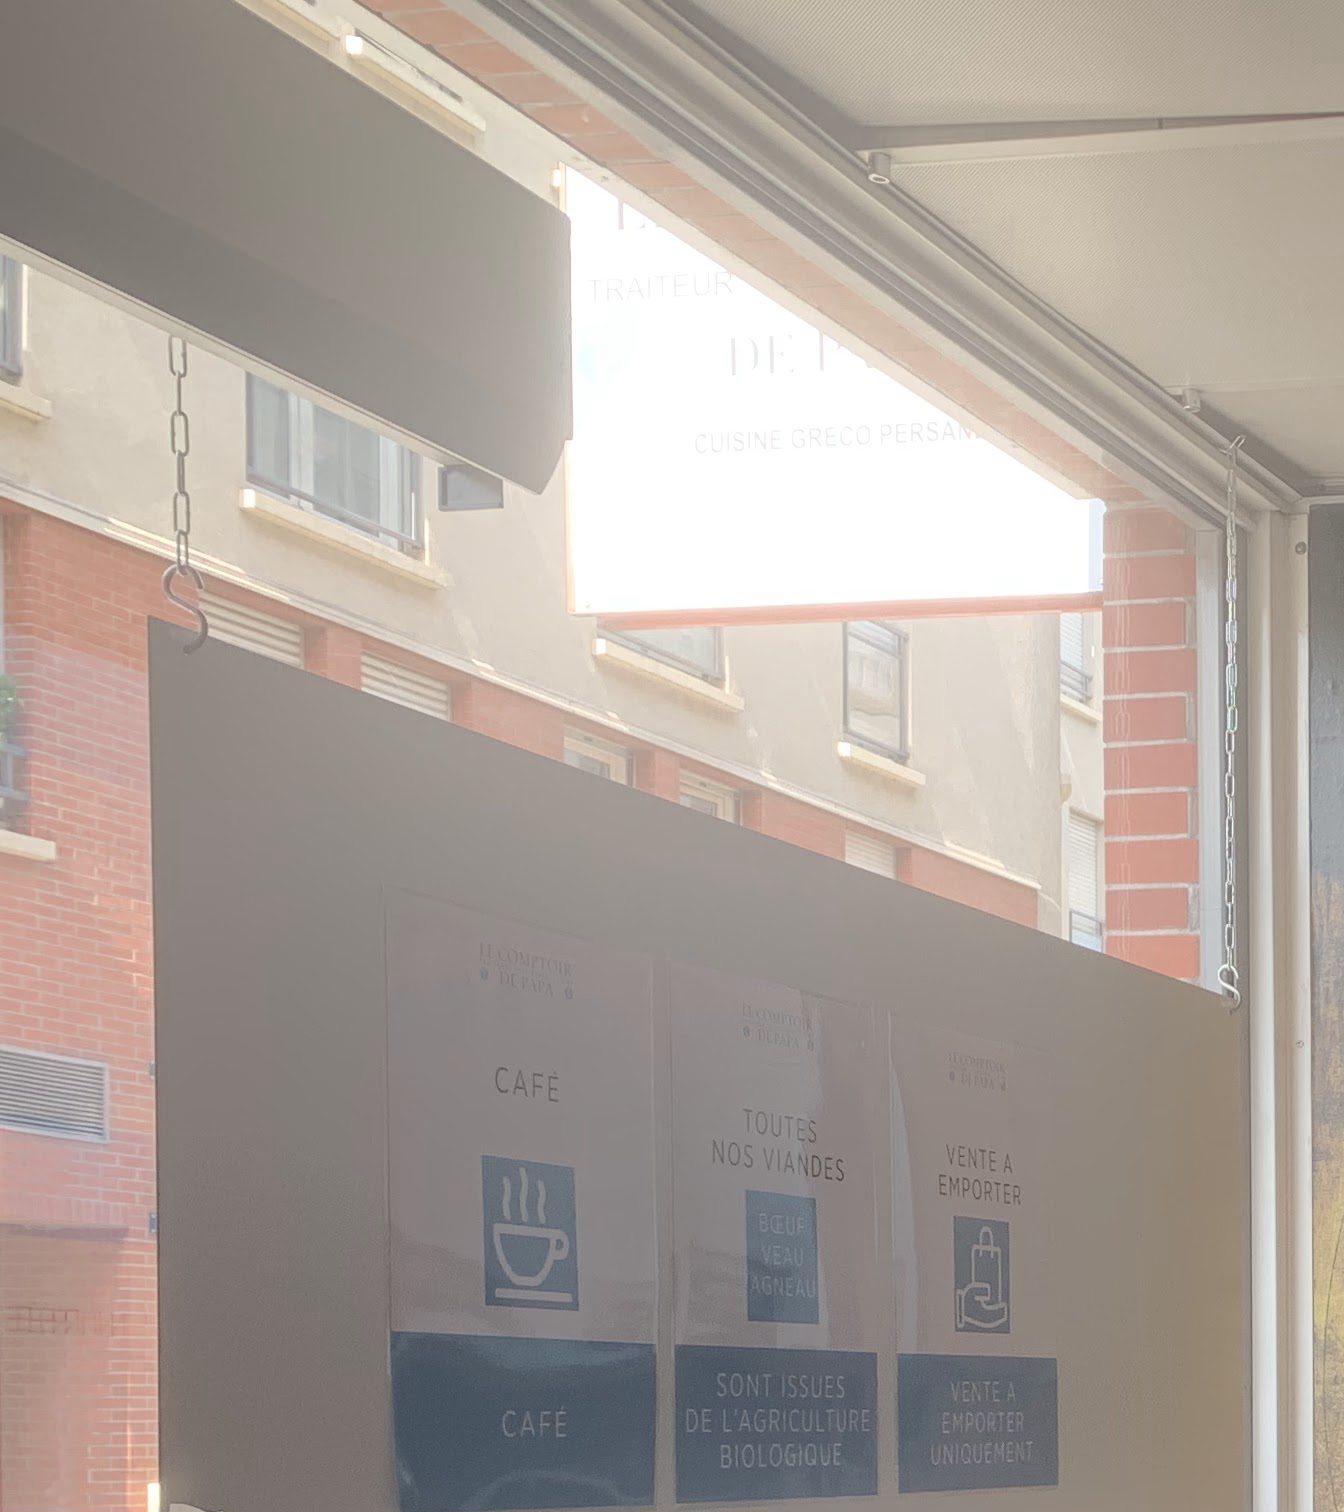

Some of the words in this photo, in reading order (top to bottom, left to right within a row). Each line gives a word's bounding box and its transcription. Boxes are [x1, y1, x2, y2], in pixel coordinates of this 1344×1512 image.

[695, 429, 783, 454] CUISINE
[792, 426, 872, 450] GRECO
[495, 1066, 559, 1103] CAFÉ
[743, 1108, 817, 1144] TOUTES
[712, 1139, 753, 1168] NOS
[763, 1147, 845, 1182] VIANDES
[946, 1144, 997, 1172] VENTE
[938, 1174, 1021, 1206] EMPORTER
[761, 1245, 804, 1267] VEAU
[751, 1275, 816, 1299] AGNEAU
[716, 1372, 771, 1398] SONT
[780, 1375, 845, 1399] ISSUES
[950, 1380, 1000, 1402] VENTE
[502, 1408, 568, 1439] CAFÉ
[685, 1409, 712, 1433] DE
[722, 1408, 871, 1433] L'AGRICULTURE
[942, 1411, 1025, 1435] EMPORTER
[720, 1443, 842, 1469] BIOLOGIQUE
[930, 1440, 1034, 1466] UNIQUEMENT
